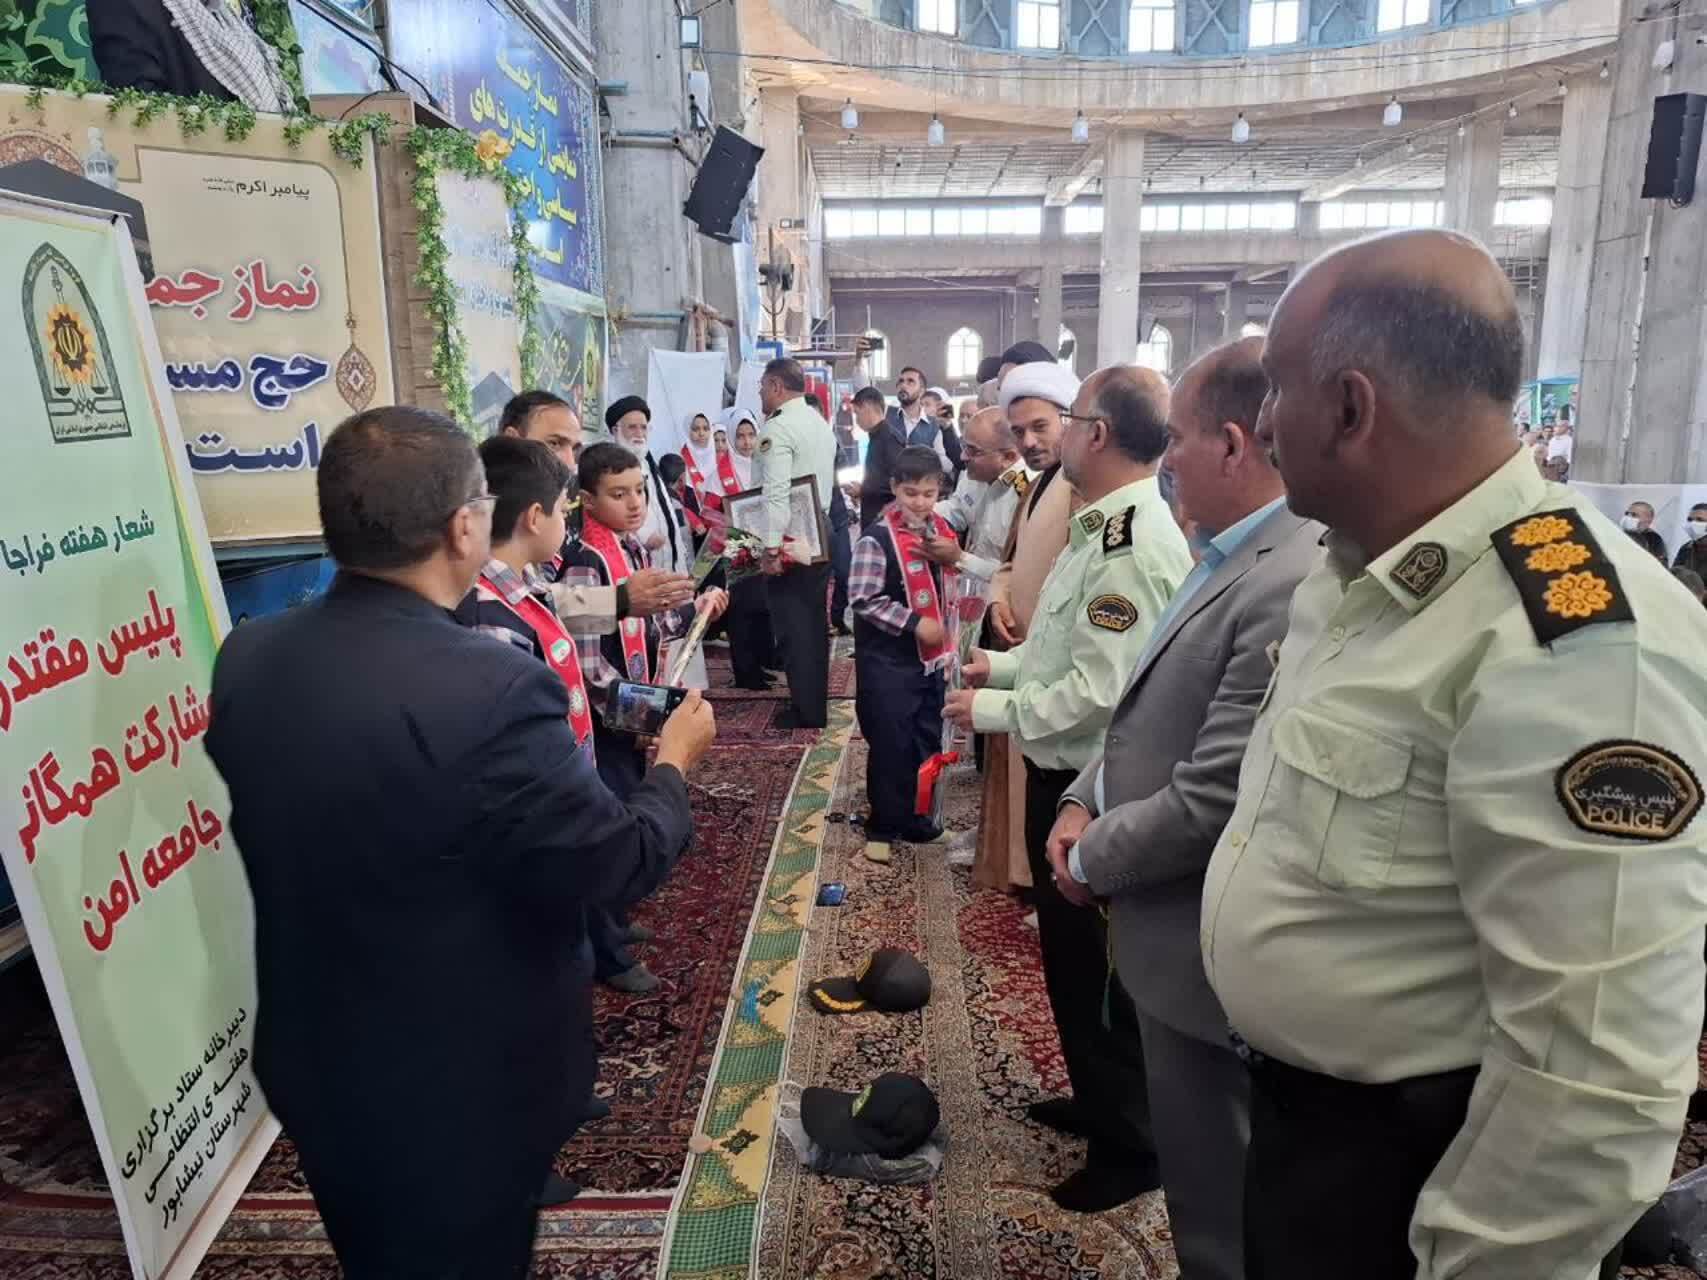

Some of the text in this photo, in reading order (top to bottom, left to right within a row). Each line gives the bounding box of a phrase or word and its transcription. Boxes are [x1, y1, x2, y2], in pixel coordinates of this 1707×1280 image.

[236, 180, 267, 195] اکرم
[269, 183, 310, 201] پیامبر
[229, 261, 318, 320] نماز
[250, 353, 328, 408] حج
[185, 422, 320, 471] است
[0, 509, 155, 576] شعار هفته فراجا
[97, 590, 182, 675] پلیس
[1588, 805, 1665, 829] POLICE
[83, 800, 223, 951] جامعه امن
[177, 1064, 204, 1103] ستاد
[212, 1047, 249, 1097] هفته
[144, 1105, 200, 1204] انتظامی
[162, 1081, 252, 1229] شهرستان نیشابور
